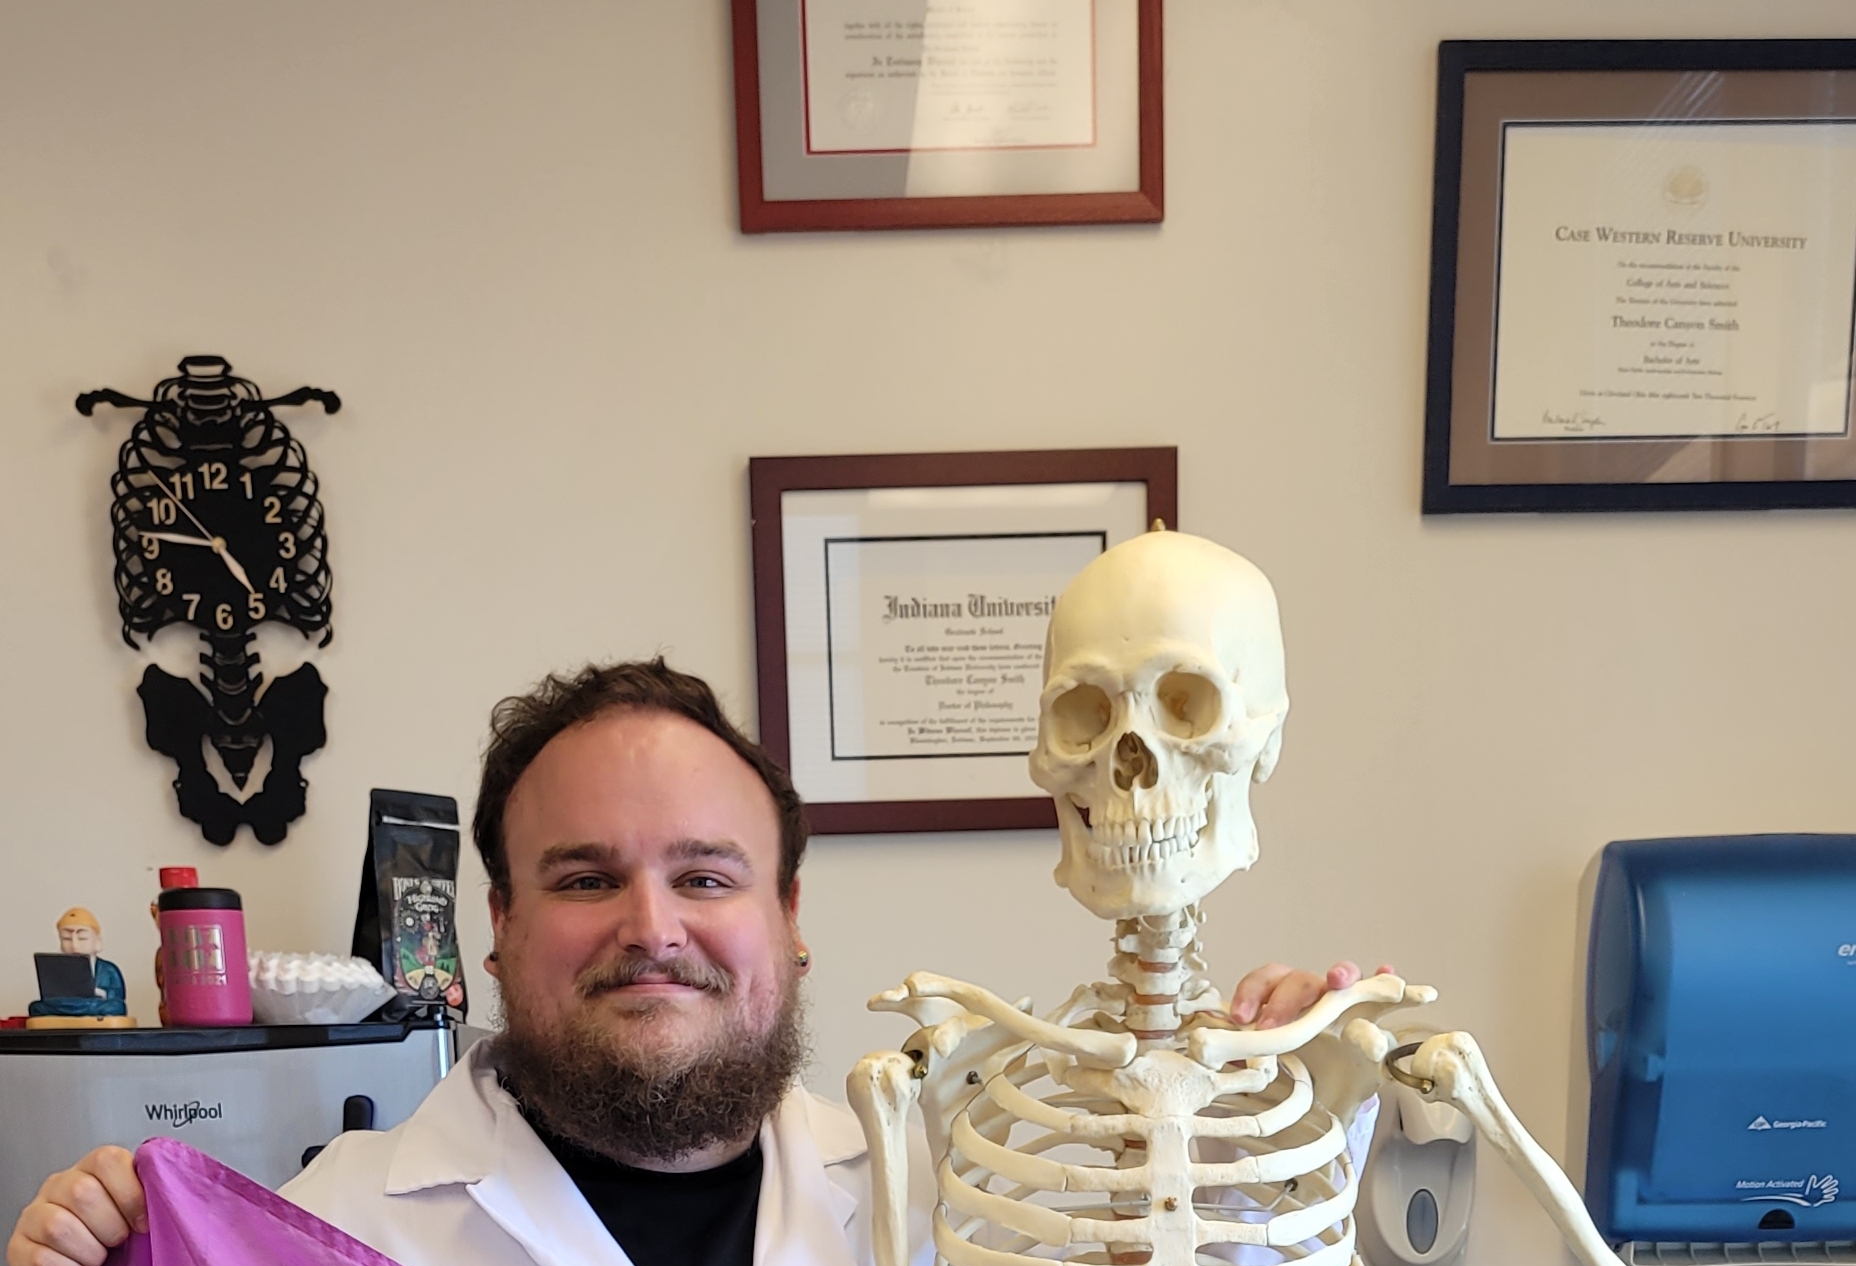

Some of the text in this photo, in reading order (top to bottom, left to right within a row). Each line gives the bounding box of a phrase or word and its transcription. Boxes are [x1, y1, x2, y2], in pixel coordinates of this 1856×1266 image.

[168, 472, 195, 500] 11
[198, 462, 229, 490] 12
[239, 472, 253, 500] 1
[146, 497, 177, 526] 10
[263, 496, 282, 524] 2
[141, 533, 160, 560] 9
[278, 531, 296, 559] 3
[155, 568, 174, 595] 8
[269, 566, 288, 594] 4
[182, 593, 201, 621] 7
[215, 603, 234, 630] 6
[248, 592, 266, 620] 5
[882, 595, 963, 624] Indiana
[144, 1100, 222, 1128] Whirlpool
[1735, 1179, 1805, 1189] Motion Activated
